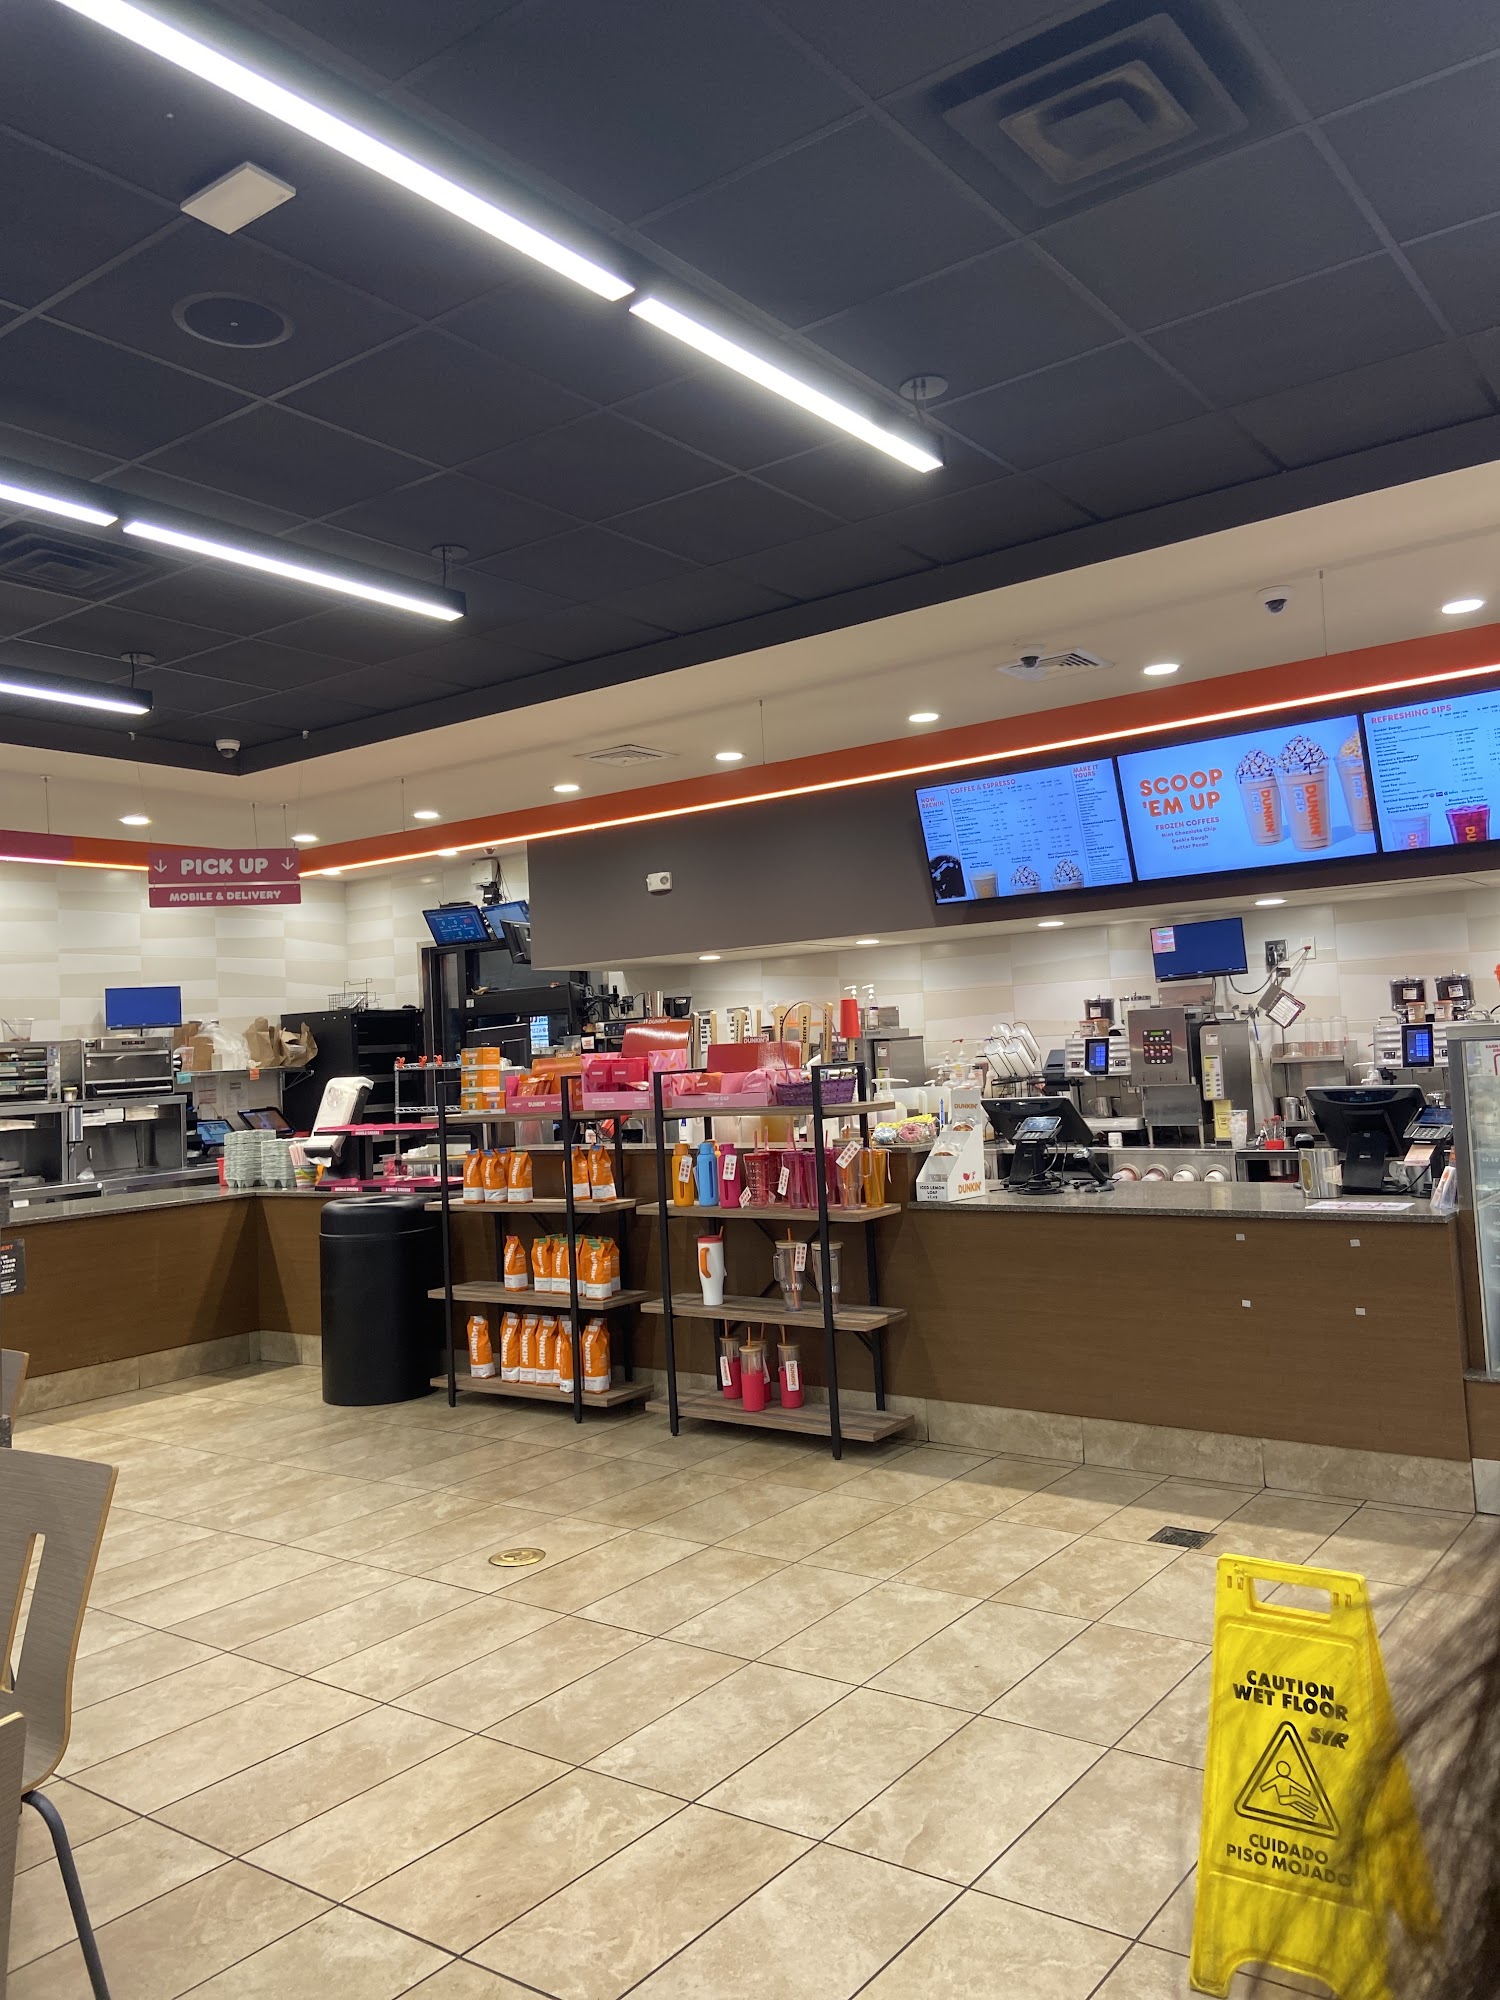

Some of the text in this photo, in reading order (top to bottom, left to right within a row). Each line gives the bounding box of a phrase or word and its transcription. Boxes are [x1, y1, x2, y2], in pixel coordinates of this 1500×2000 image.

[1371, 708, 1429, 725] REFRESHING
[1431, 704, 1452, 715] SIPS
[1073, 766, 1091, 774] MAKE
[1073, 771, 1096, 779] YOURS
[1139, 768, 1223, 798] SCOOP
[950, 784, 976, 795] COFFEE
[982, 779, 1016, 790] ESPRESSO
[1292, 786, 1305, 814] ICED
[1142, 790, 1222, 818] 'EM UP
[1260, 788, 1276, 835] DUNKIN'
[1304, 783, 1323, 838] DUNKIN'
[1155, 815, 1220, 832] FROZEN COFFEES
[1161, 825, 1217, 839] Mint Chocolate Chip
[180, 857, 269, 876] PICK UP
[169, 890, 281, 902] MOBILE & DELIVERY
[743, 1036, 769, 1044] DUNKIN'
[466, 1157, 477, 1185] DUNKIN'
[485, 1159, 493, 1187] DUNKIN'
[511, 1157, 521, 1186] DUNKIN'
[957, 1181, 982, 1194] DUNKIN'
[505, 1243, 515, 1273] DUNKIN'
[555, 1246, 565, 1275] DUNKIN'
[590, 1251, 598, 1281] DUNKIN'
[471, 1325, 480, 1362] DUNKIN'
[502, 1327, 513, 1365] DUNKIN'
[521, 1328, 532, 1365] DUNKIN'
[539, 1328, 549, 1367] DUNKIN'
[584, 1334, 594, 1374] DUNKIN'
[1246, 1669, 1335, 1701] CAUTION
[1232, 1683, 1349, 1722] WET FLOOR
[1248, 1833, 1329, 1865] CUIDADO
[1226, 1843, 1352, 1888] PISO MOJADO
